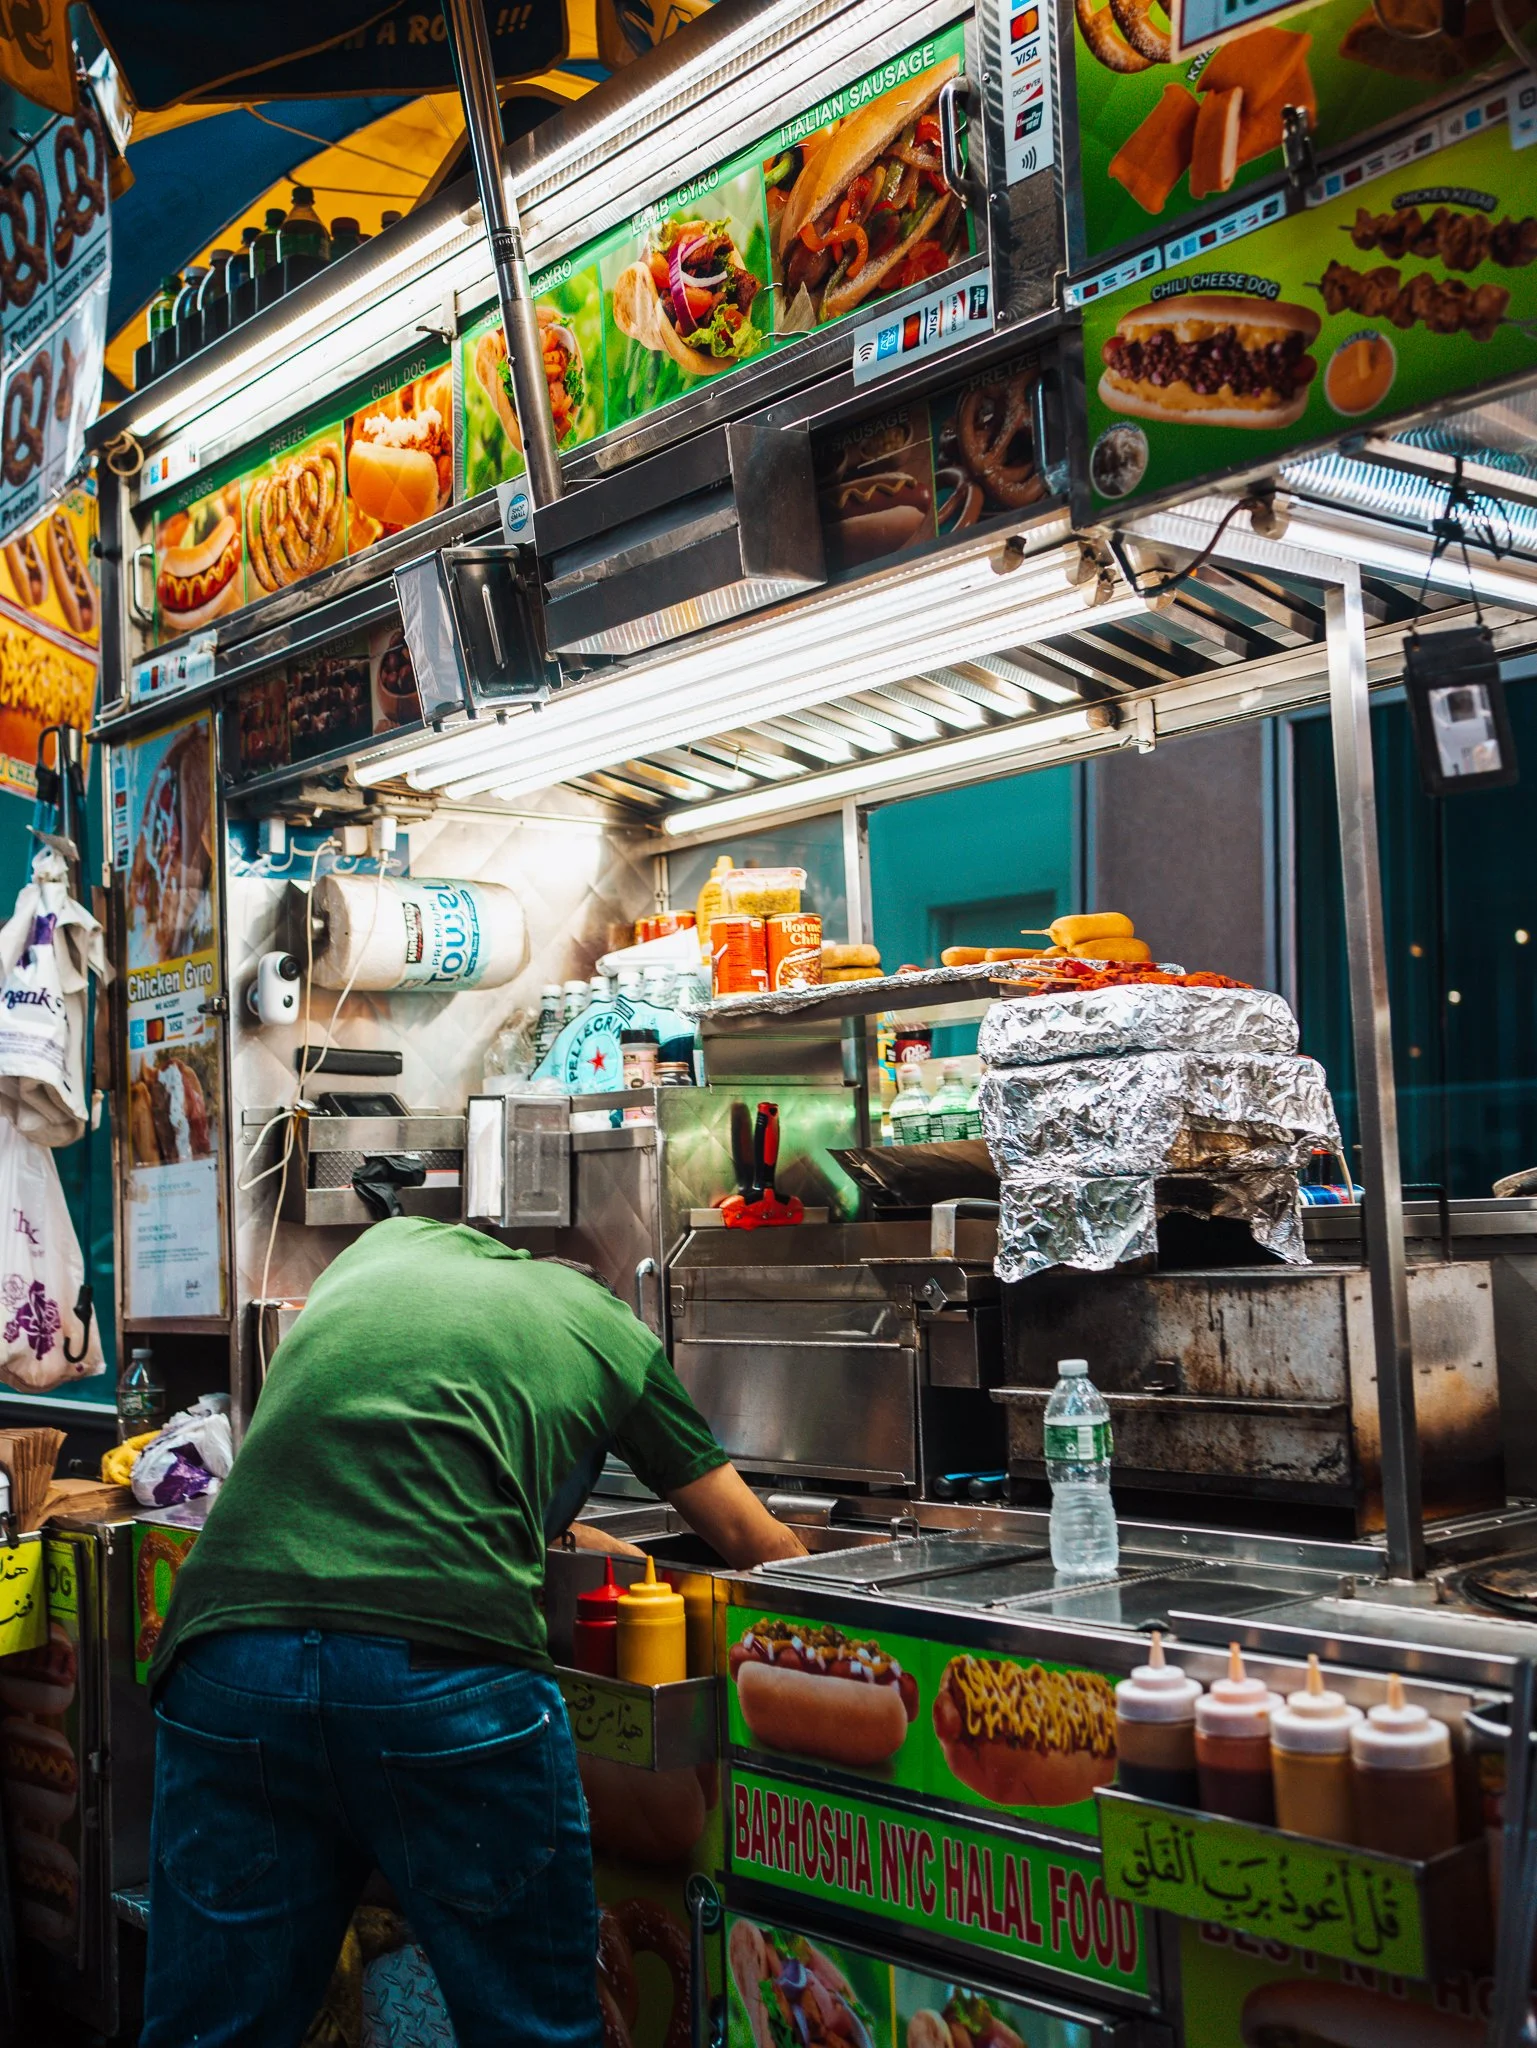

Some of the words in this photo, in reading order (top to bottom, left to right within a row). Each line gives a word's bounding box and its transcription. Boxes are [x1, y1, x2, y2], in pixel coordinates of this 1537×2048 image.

[1015, 46, 1038, 66] VISA
[780, 94, 845, 148] ITALIAN
[849, 43, 936, 109] SAUSAGE
[631, 196, 670, 237] LAMB
[677, 168, 720, 207] GYRO
[1152, 277, 1188, 301] CHILI
[1190, 273, 1245, 290] CHEESE
[1247, 275, 1279, 299] DOG
[929, 306, 939, 337] VISA
[371, 376, 399, 400] CHILI
[403, 359, 427, 383] DOG
[269, 424, 310, 455] PRETZEL
[832, 408, 911, 453] SAUSAGE
[177, 491, 194, 508] HOT
[195, 479, 214, 499] DOG
[422, 884, 467, 986] Towel
[429, 900, 442, 966] PREMIUM
[789, 932, 820, 946] Chili
[127, 968, 180, 1004] Chicken
[184, 959, 214, 990] Gyro
[169, 1020, 184, 1033] VISA
[568, 1015, 630, 1083] PELLEGRIN
[575, 1709, 615, 1742] من
[734, 1783, 875, 1898] BARHOSHA
[878, 1820, 938, 1916] NYC
[943, 1836, 1044, 1947] HALAL
[1046, 1864, 1140, 1975] FOOD
